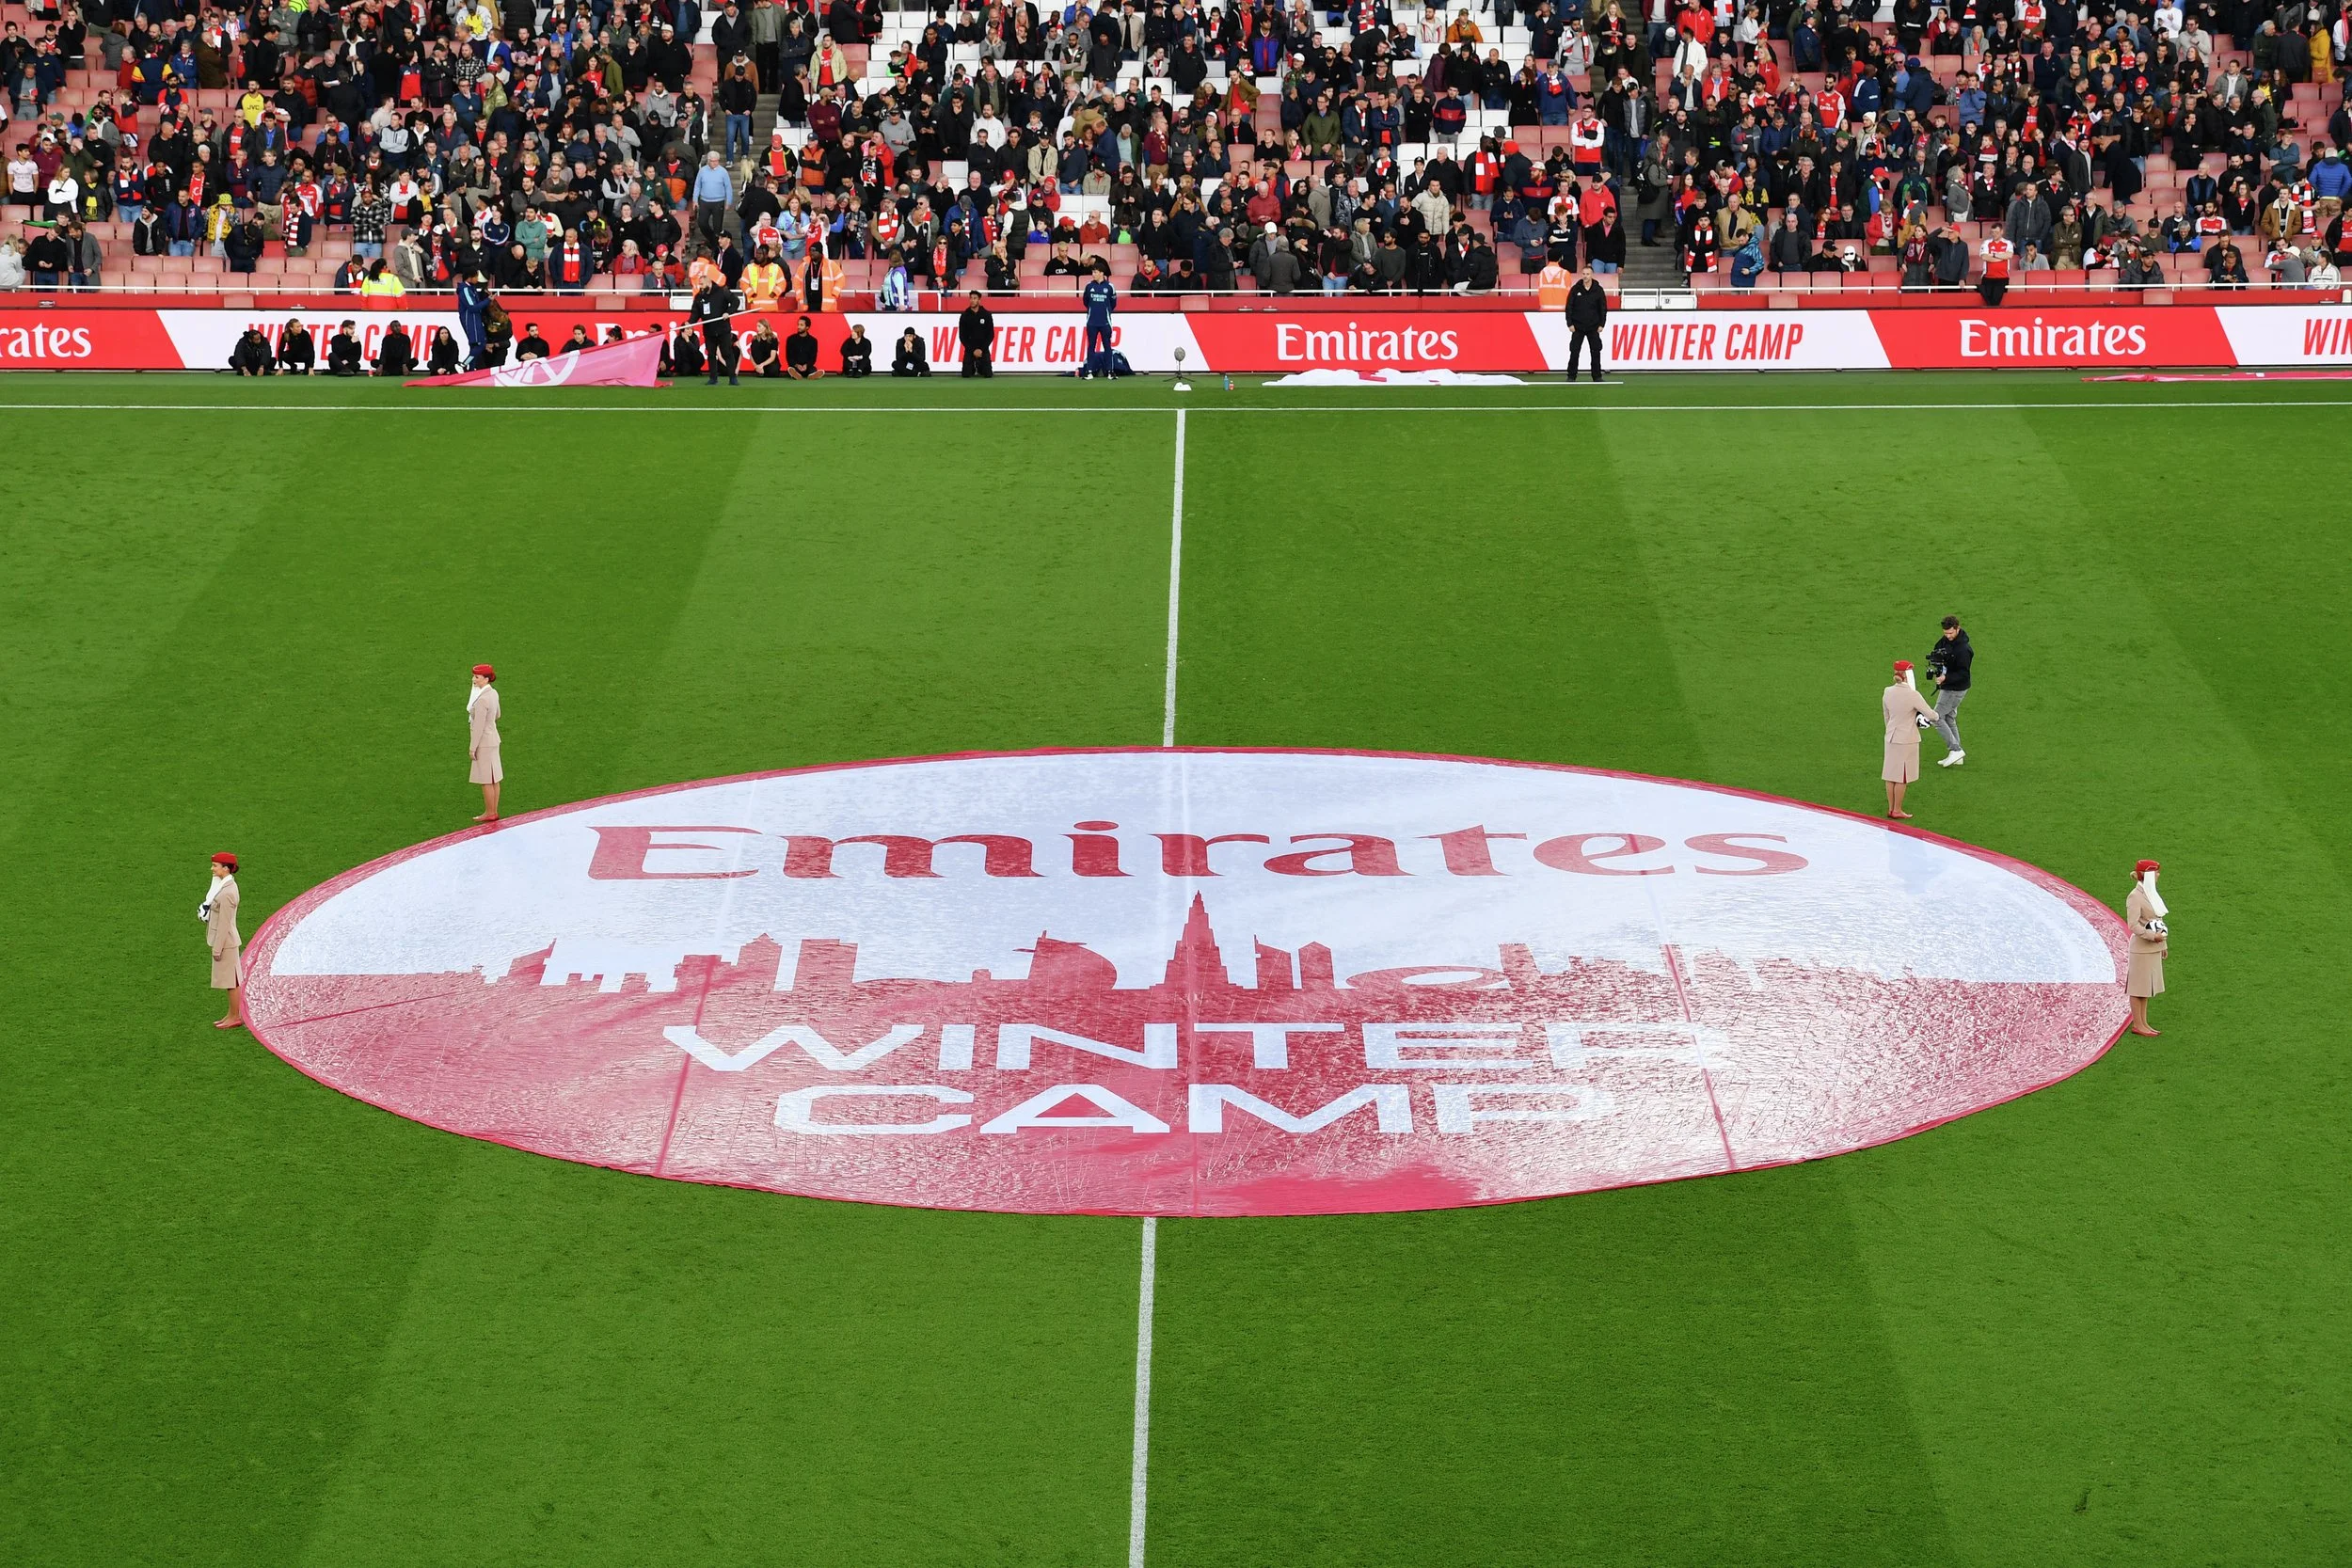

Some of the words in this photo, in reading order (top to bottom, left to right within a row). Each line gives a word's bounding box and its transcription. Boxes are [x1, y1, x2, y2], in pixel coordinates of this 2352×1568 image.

[932, 325, 1036, 363] WTER
[1275, 321, 1459, 361] Emirates
[1612, 324, 1717, 361] WINTER
[1724, 324, 1804, 360] CAMP
[1959, 316, 2147, 357] Emirates
[587, 820, 1809, 880] Emirates
[662, 1022, 1734, 1072] WINTER
[773, 1083, 1615, 1133] CAMP
